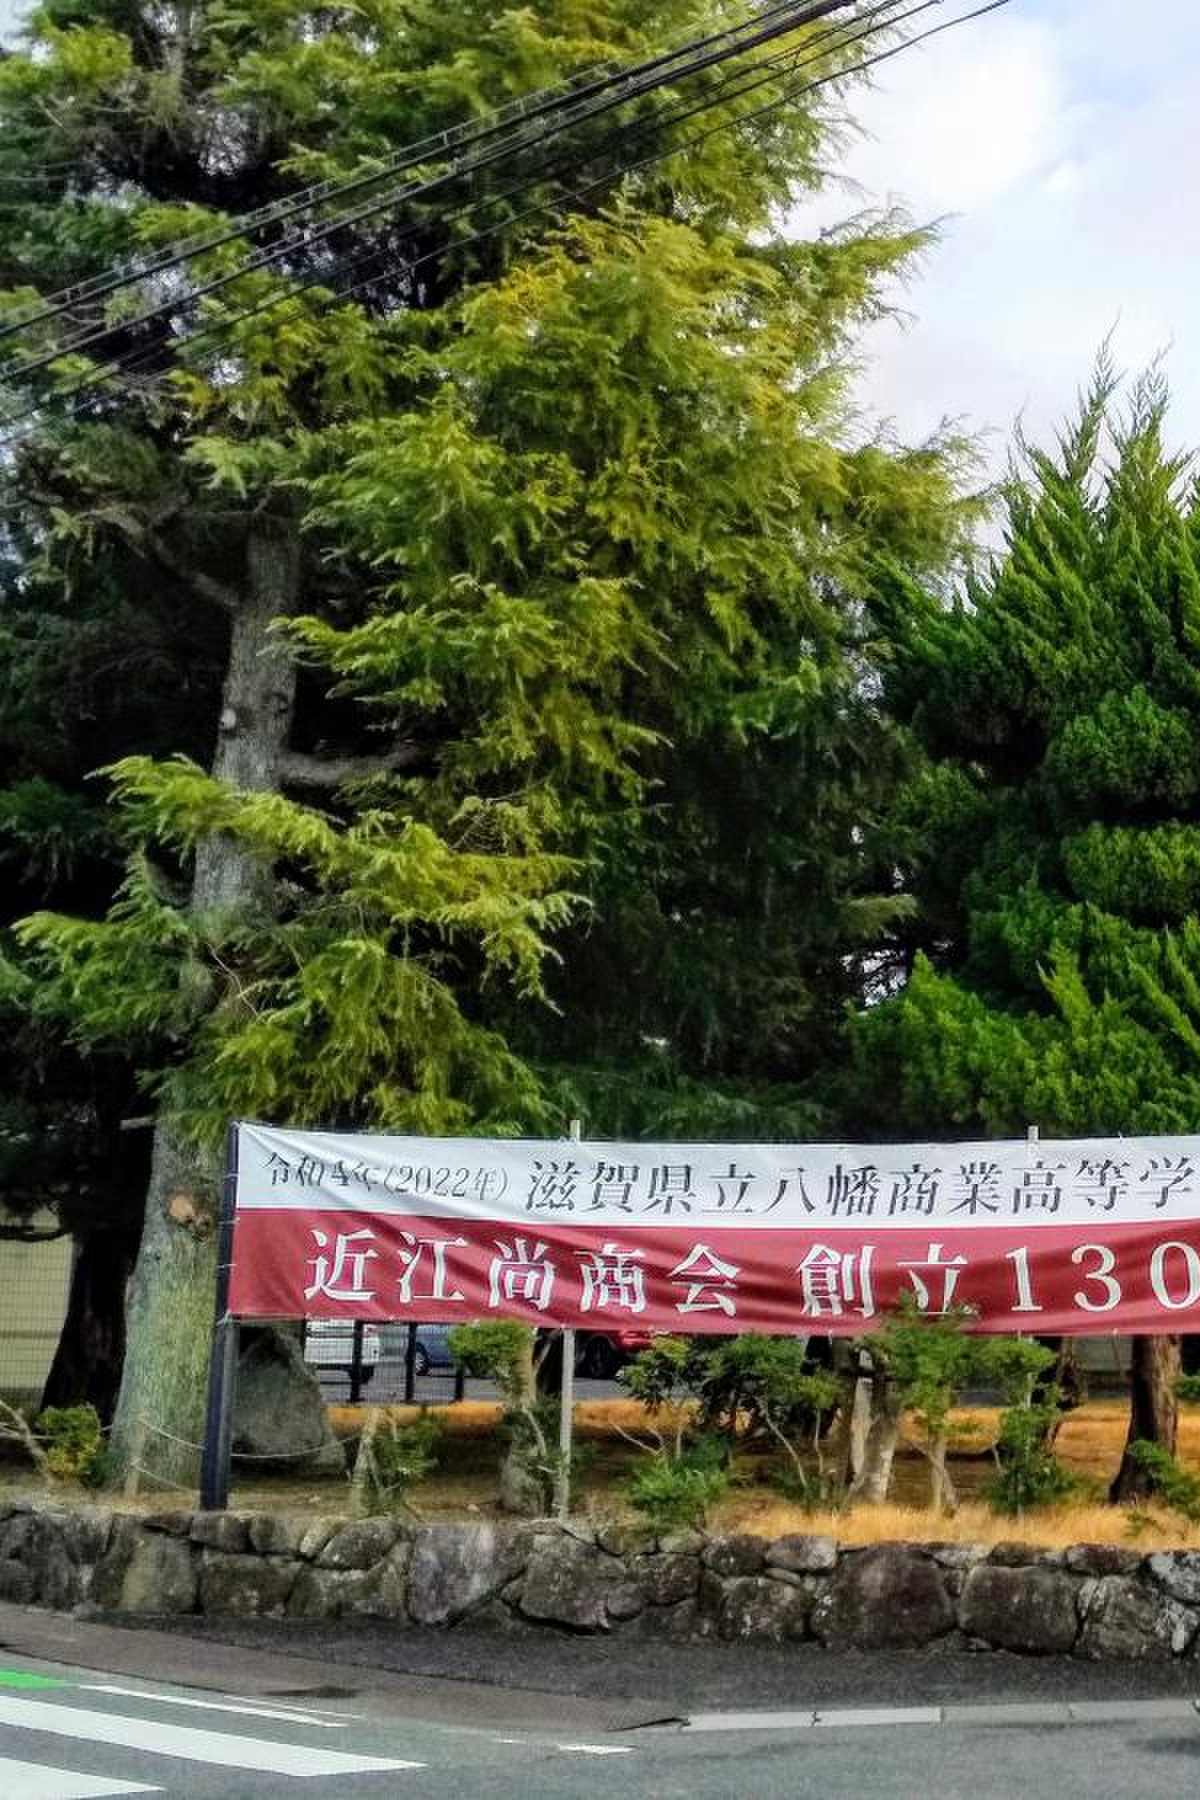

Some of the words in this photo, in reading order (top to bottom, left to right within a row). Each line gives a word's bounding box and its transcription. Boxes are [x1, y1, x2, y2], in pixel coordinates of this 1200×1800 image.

[304, 1229, 740, 1318] 近江尚商会
